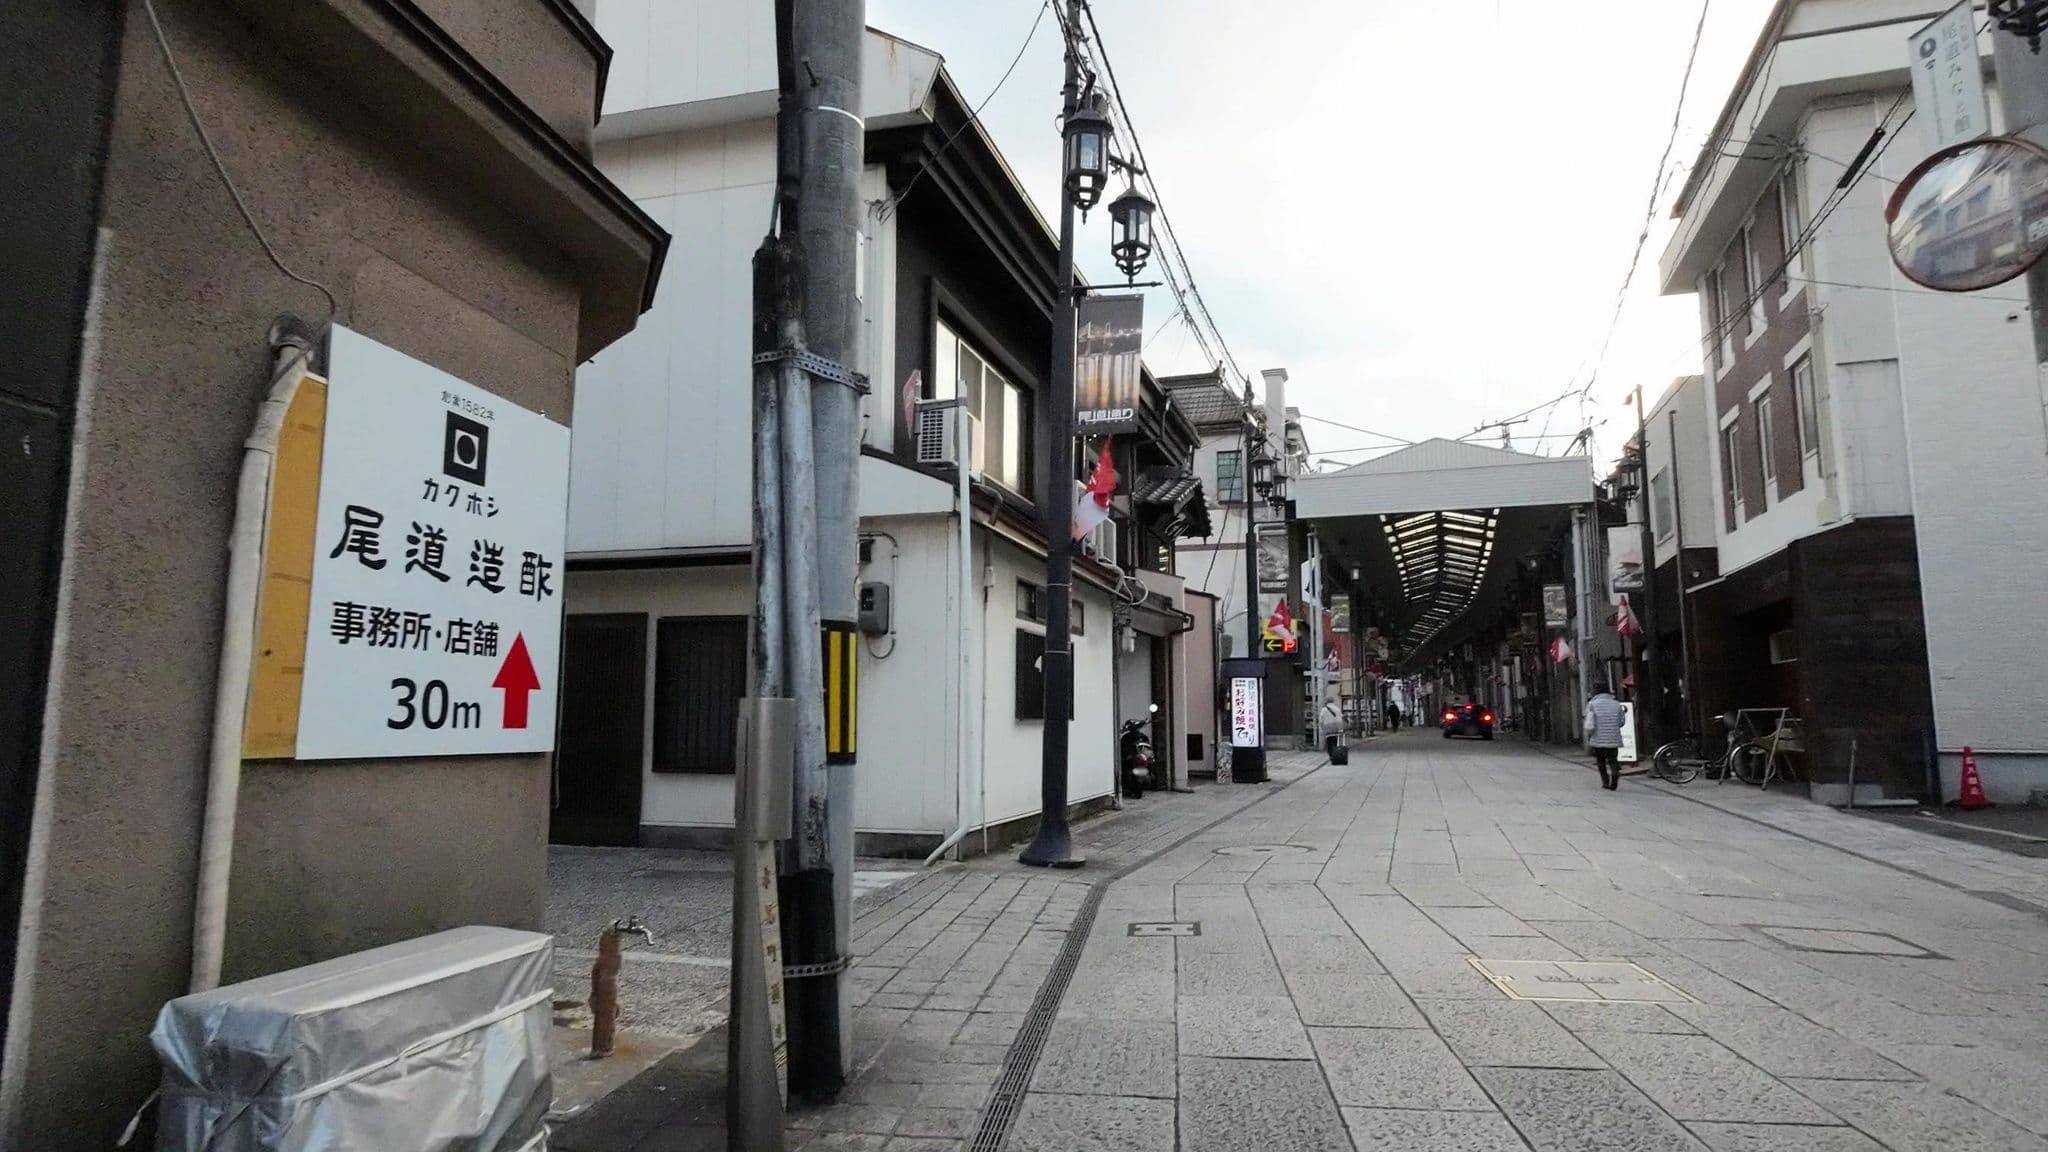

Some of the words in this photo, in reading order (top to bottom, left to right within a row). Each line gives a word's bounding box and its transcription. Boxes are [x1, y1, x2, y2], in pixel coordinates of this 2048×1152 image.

[422, 478, 499, 517] カクホシ
[329, 504, 554, 602] 尾道造酢
[386, 677, 482, 730] 30m
